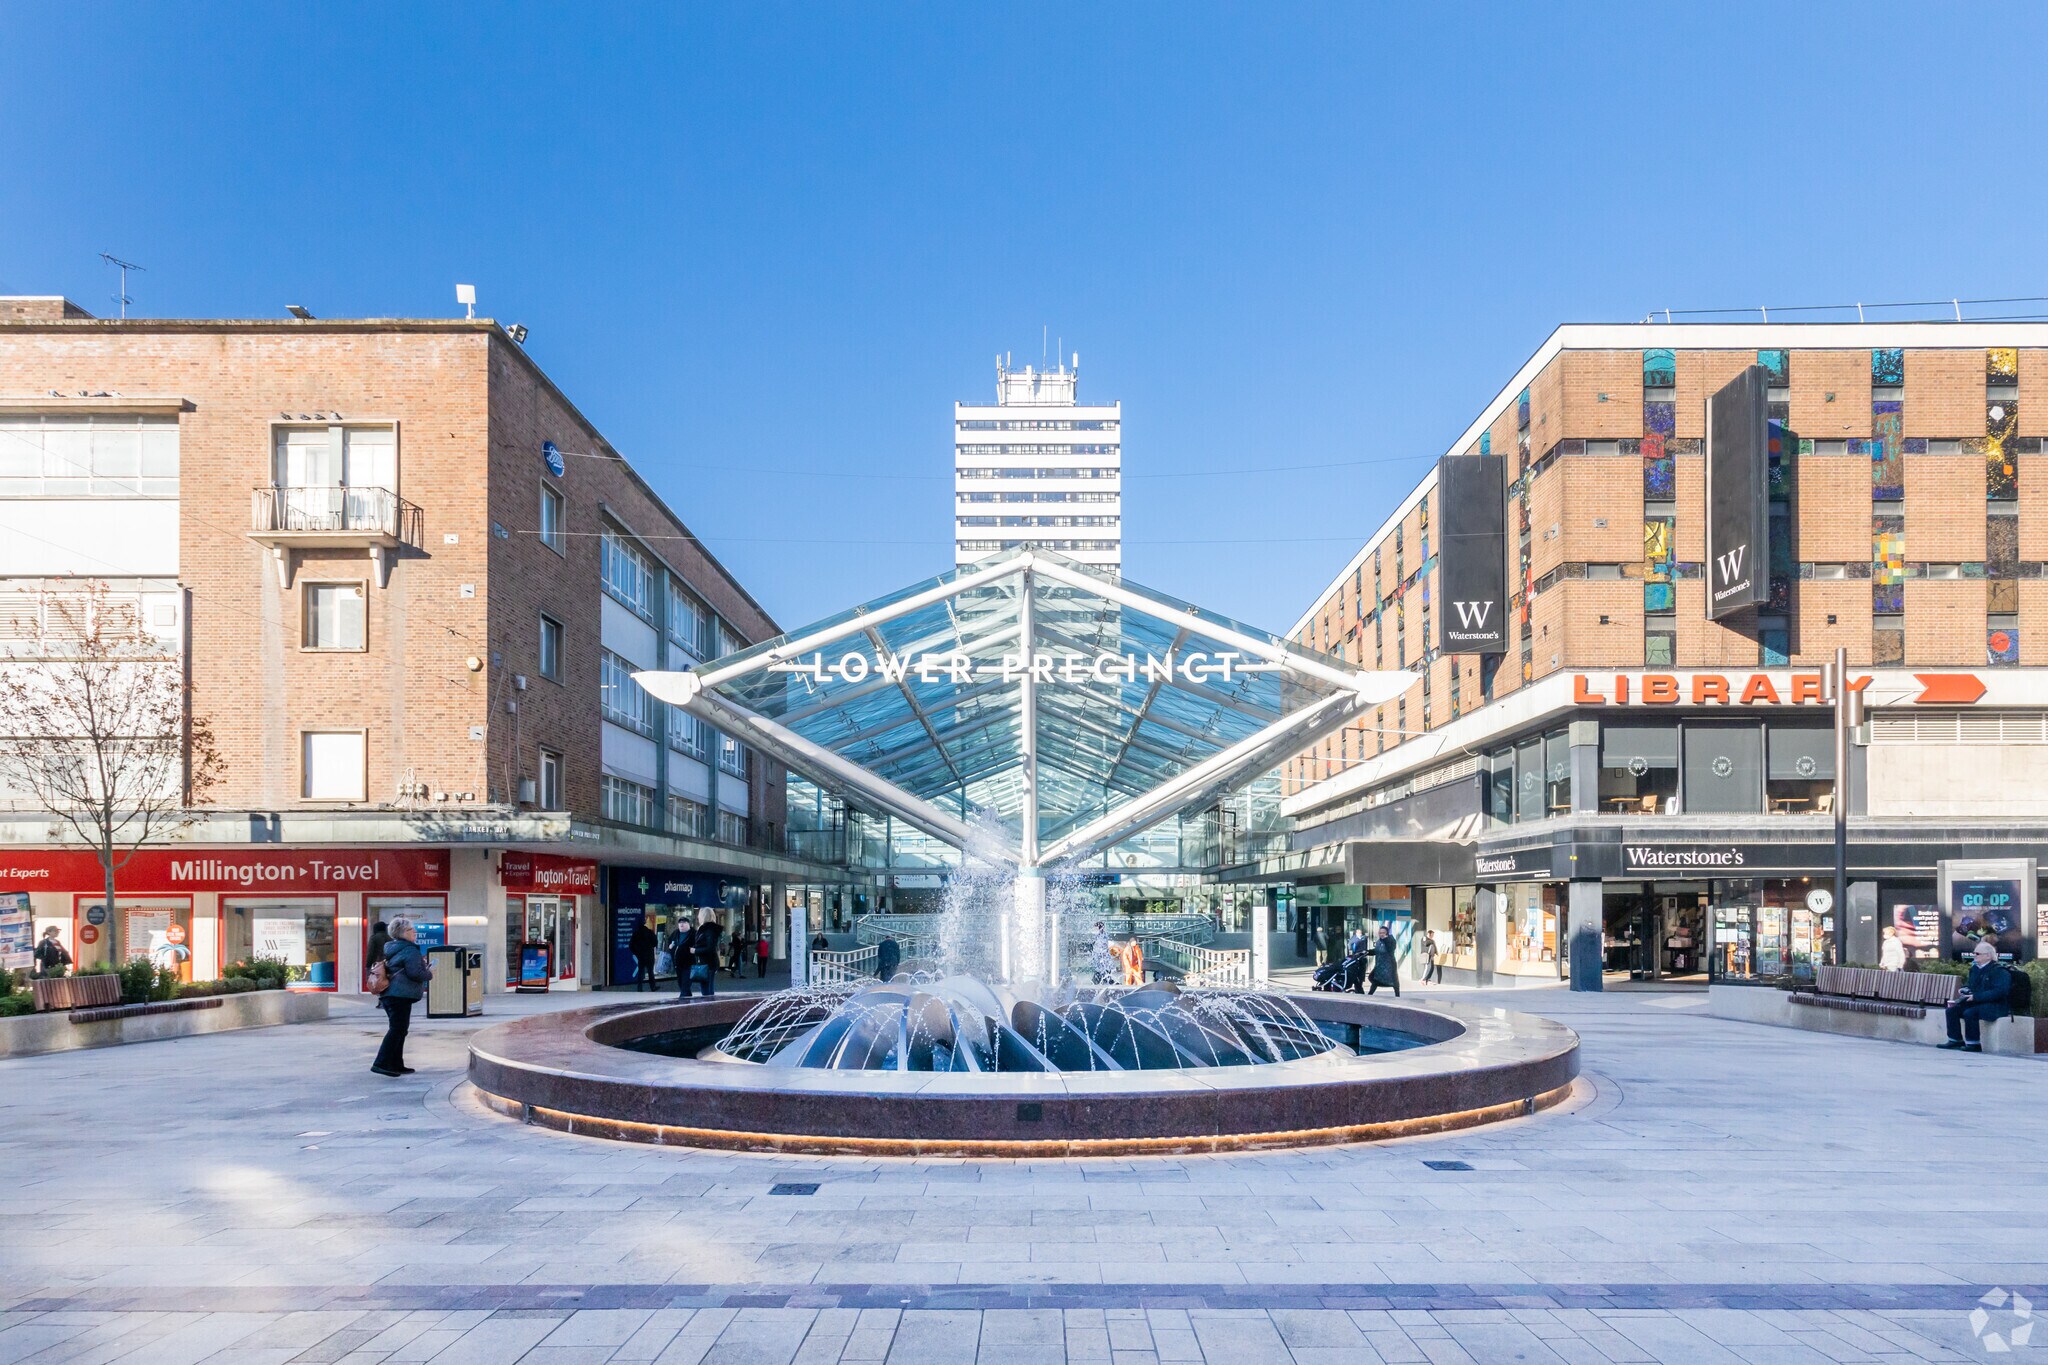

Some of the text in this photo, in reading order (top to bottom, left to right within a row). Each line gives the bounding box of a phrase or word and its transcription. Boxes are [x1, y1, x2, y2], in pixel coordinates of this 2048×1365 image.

[1717, 545, 1746, 585] W
[1714, 579, 1750, 601] Waterstone's
[1453, 601, 1494, 629] W
[1448, 631, 1499, 640] Waterstone's
[814, 652, 1240, 684] LOWER PRECINCT
[505, 862, 530, 870] Travel
[1476, 855, 1516, 873] Waterstone's
[1626, 848, 1744, 866] Waterstone's
[10, 868, 50, 880] Experts
[171, 860, 379, 886] Millington Travel
[535, 866, 591, 888] ington Travel
[664, 880, 693, 898] pharmacy
[1962, 894, 2010, 906] CO-OP
[617, 906, 642, 915] welcome
